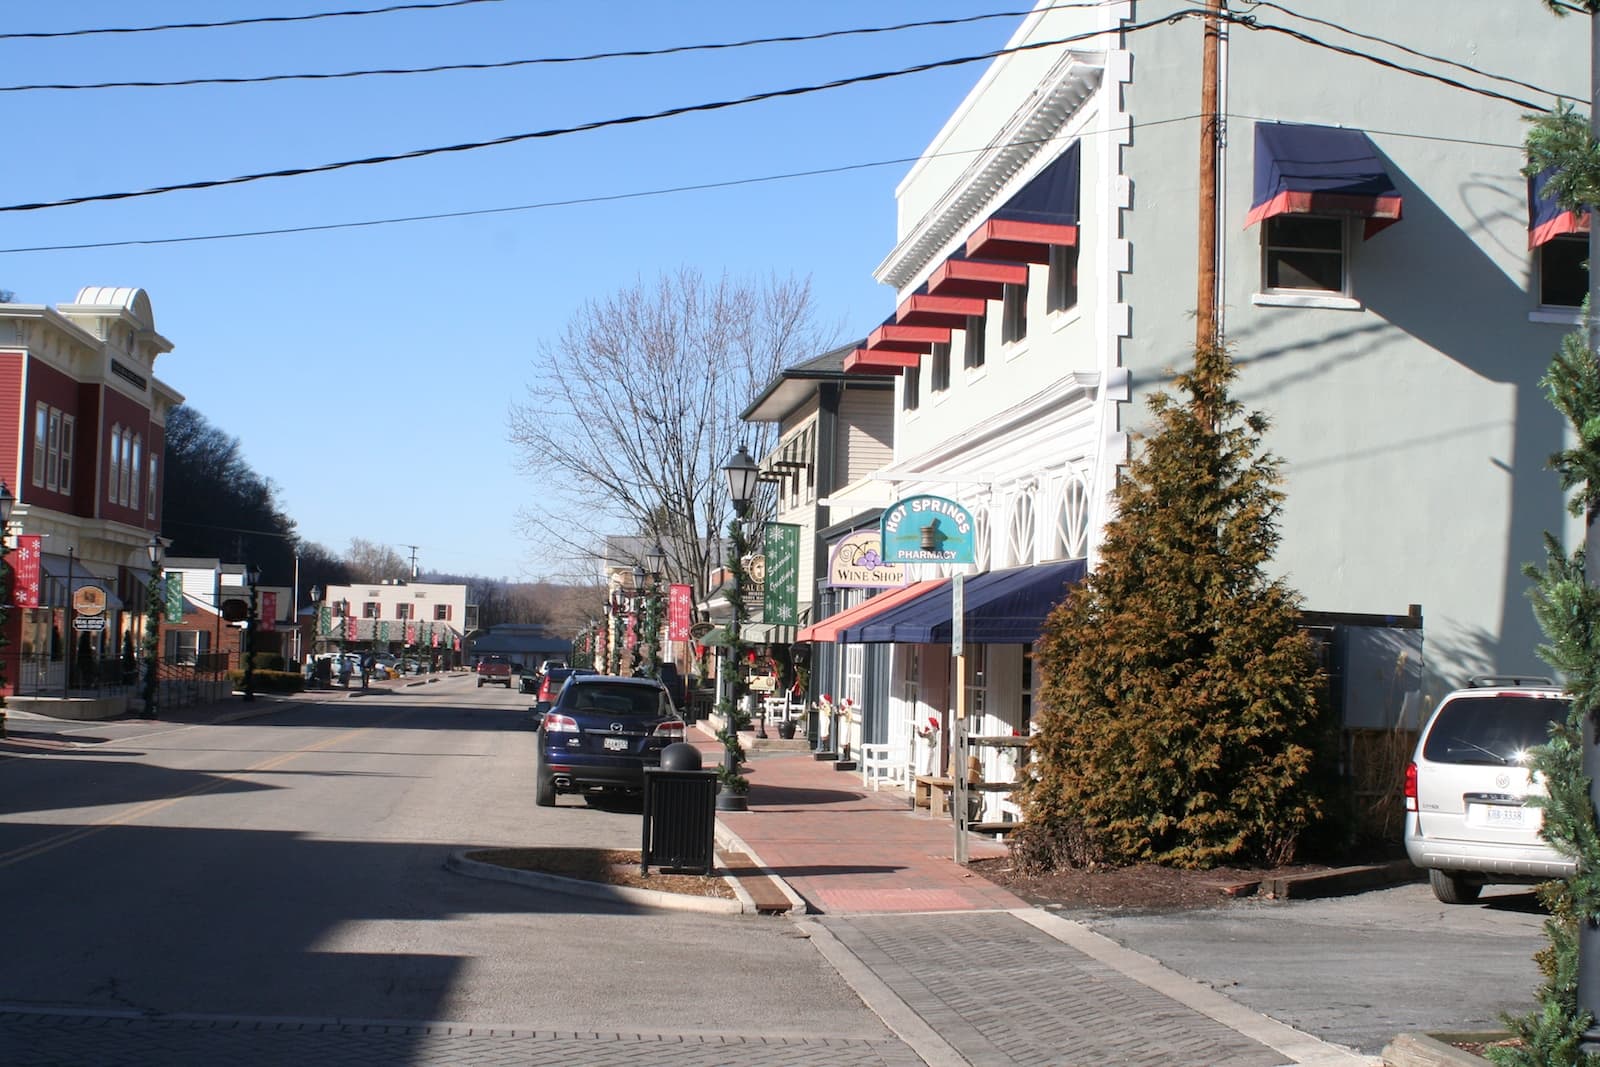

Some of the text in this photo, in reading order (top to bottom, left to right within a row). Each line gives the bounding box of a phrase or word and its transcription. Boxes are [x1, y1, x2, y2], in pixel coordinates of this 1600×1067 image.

[885, 500, 970, 535] HOT SPRINGS
[897, 550, 957, 560] PHARMACY
[838, 569, 904, 582] WINE SHOP
